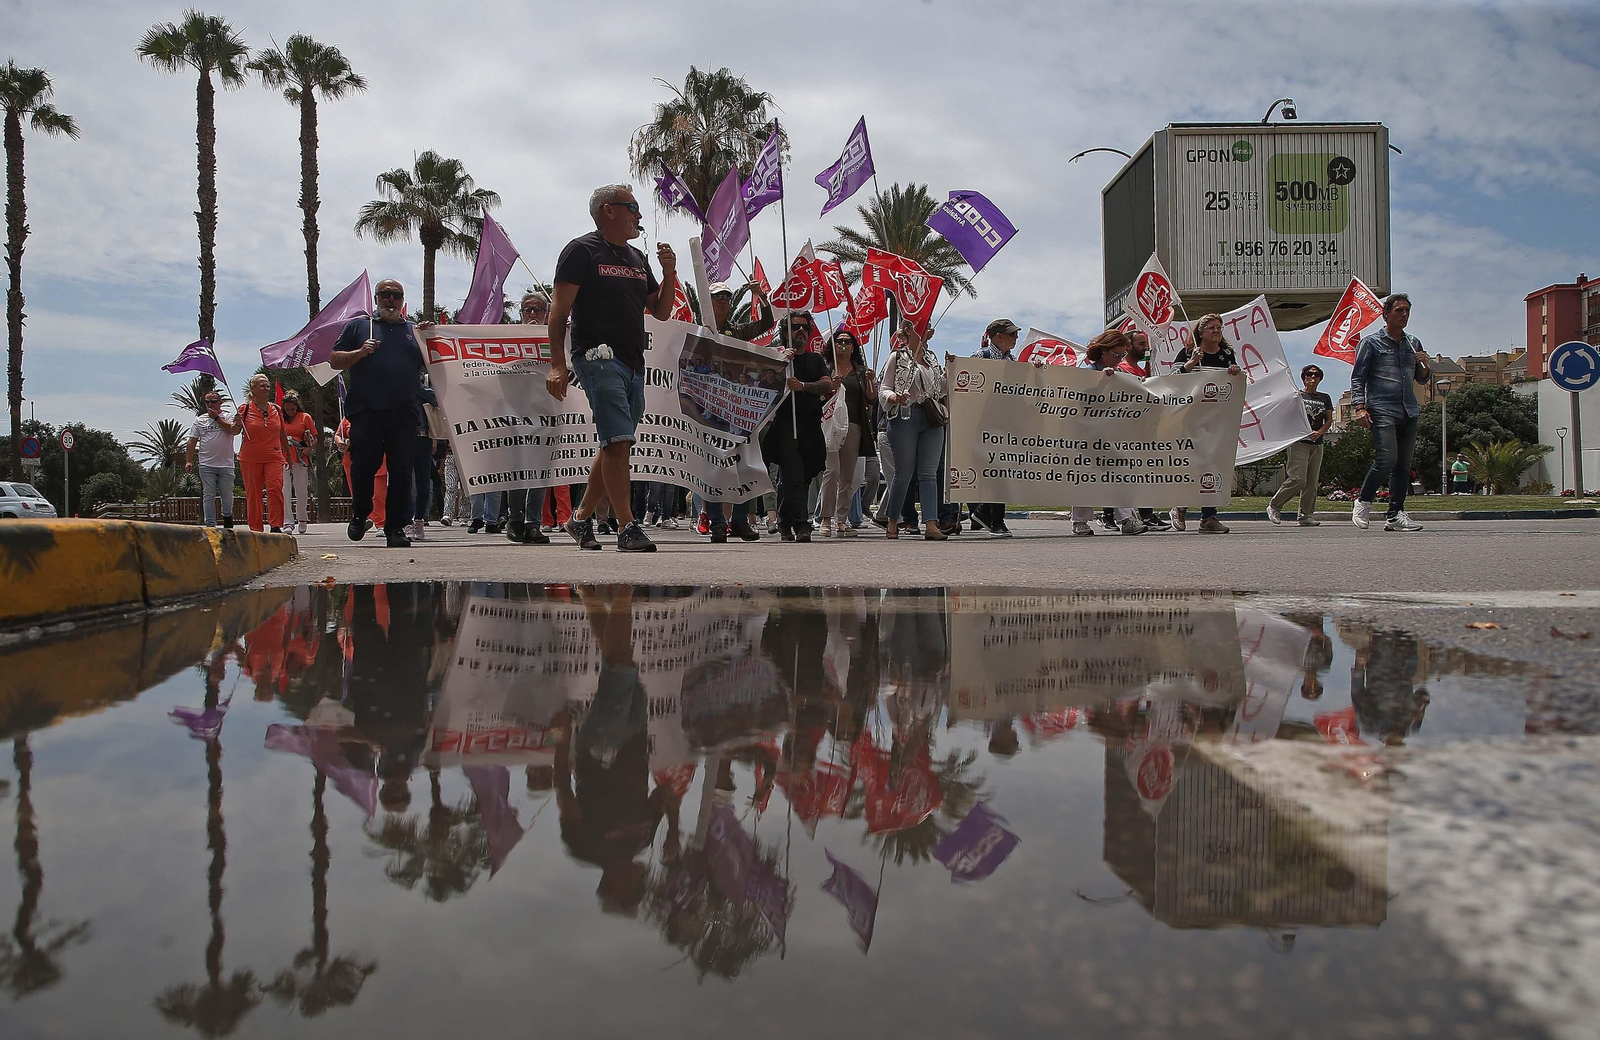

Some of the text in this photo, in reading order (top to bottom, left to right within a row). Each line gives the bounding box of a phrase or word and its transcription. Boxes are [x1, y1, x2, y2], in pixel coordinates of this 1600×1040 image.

[1186, 149, 1230, 163] GPON
[1204, 190, 1231, 211] 25
[1218, 240, 1338, 256] T. 956 76 20 34
[471, 370, 480, 378] la
[511, 361, 523, 371] de
[738, 386, 746, 395] LA
[747, 387, 769, 400] LINEA
[993, 381, 1055, 399] Residencia
[1056, 387, 1106, 407] Tiempo
[1109, 391, 1143, 405] Libre
[1146, 393, 1161, 405] La
[453, 420, 480, 436] LA
[482, 415, 535, 430] LINEA
[64, 436, 73, 444] 30
[639, 432, 704, 459] RESIDENCIA
[982, 432, 1195, 451] Por la cobertura de vacantes YA
[579, 447, 596, 459] DE
[630, 447, 688, 464] INEA YA!
[988, 451, 1190, 470] y ampliación de tiempo en los
[468, 470, 538, 487] COBERTURA
[553, 465, 590, 478] TODAS
[982, 468, 1042, 481] contratos
[1045, 469, 1063, 482] de
[1066, 470, 1097, 486] fijos
[1100, 471, 1195, 484] discontinuos.
